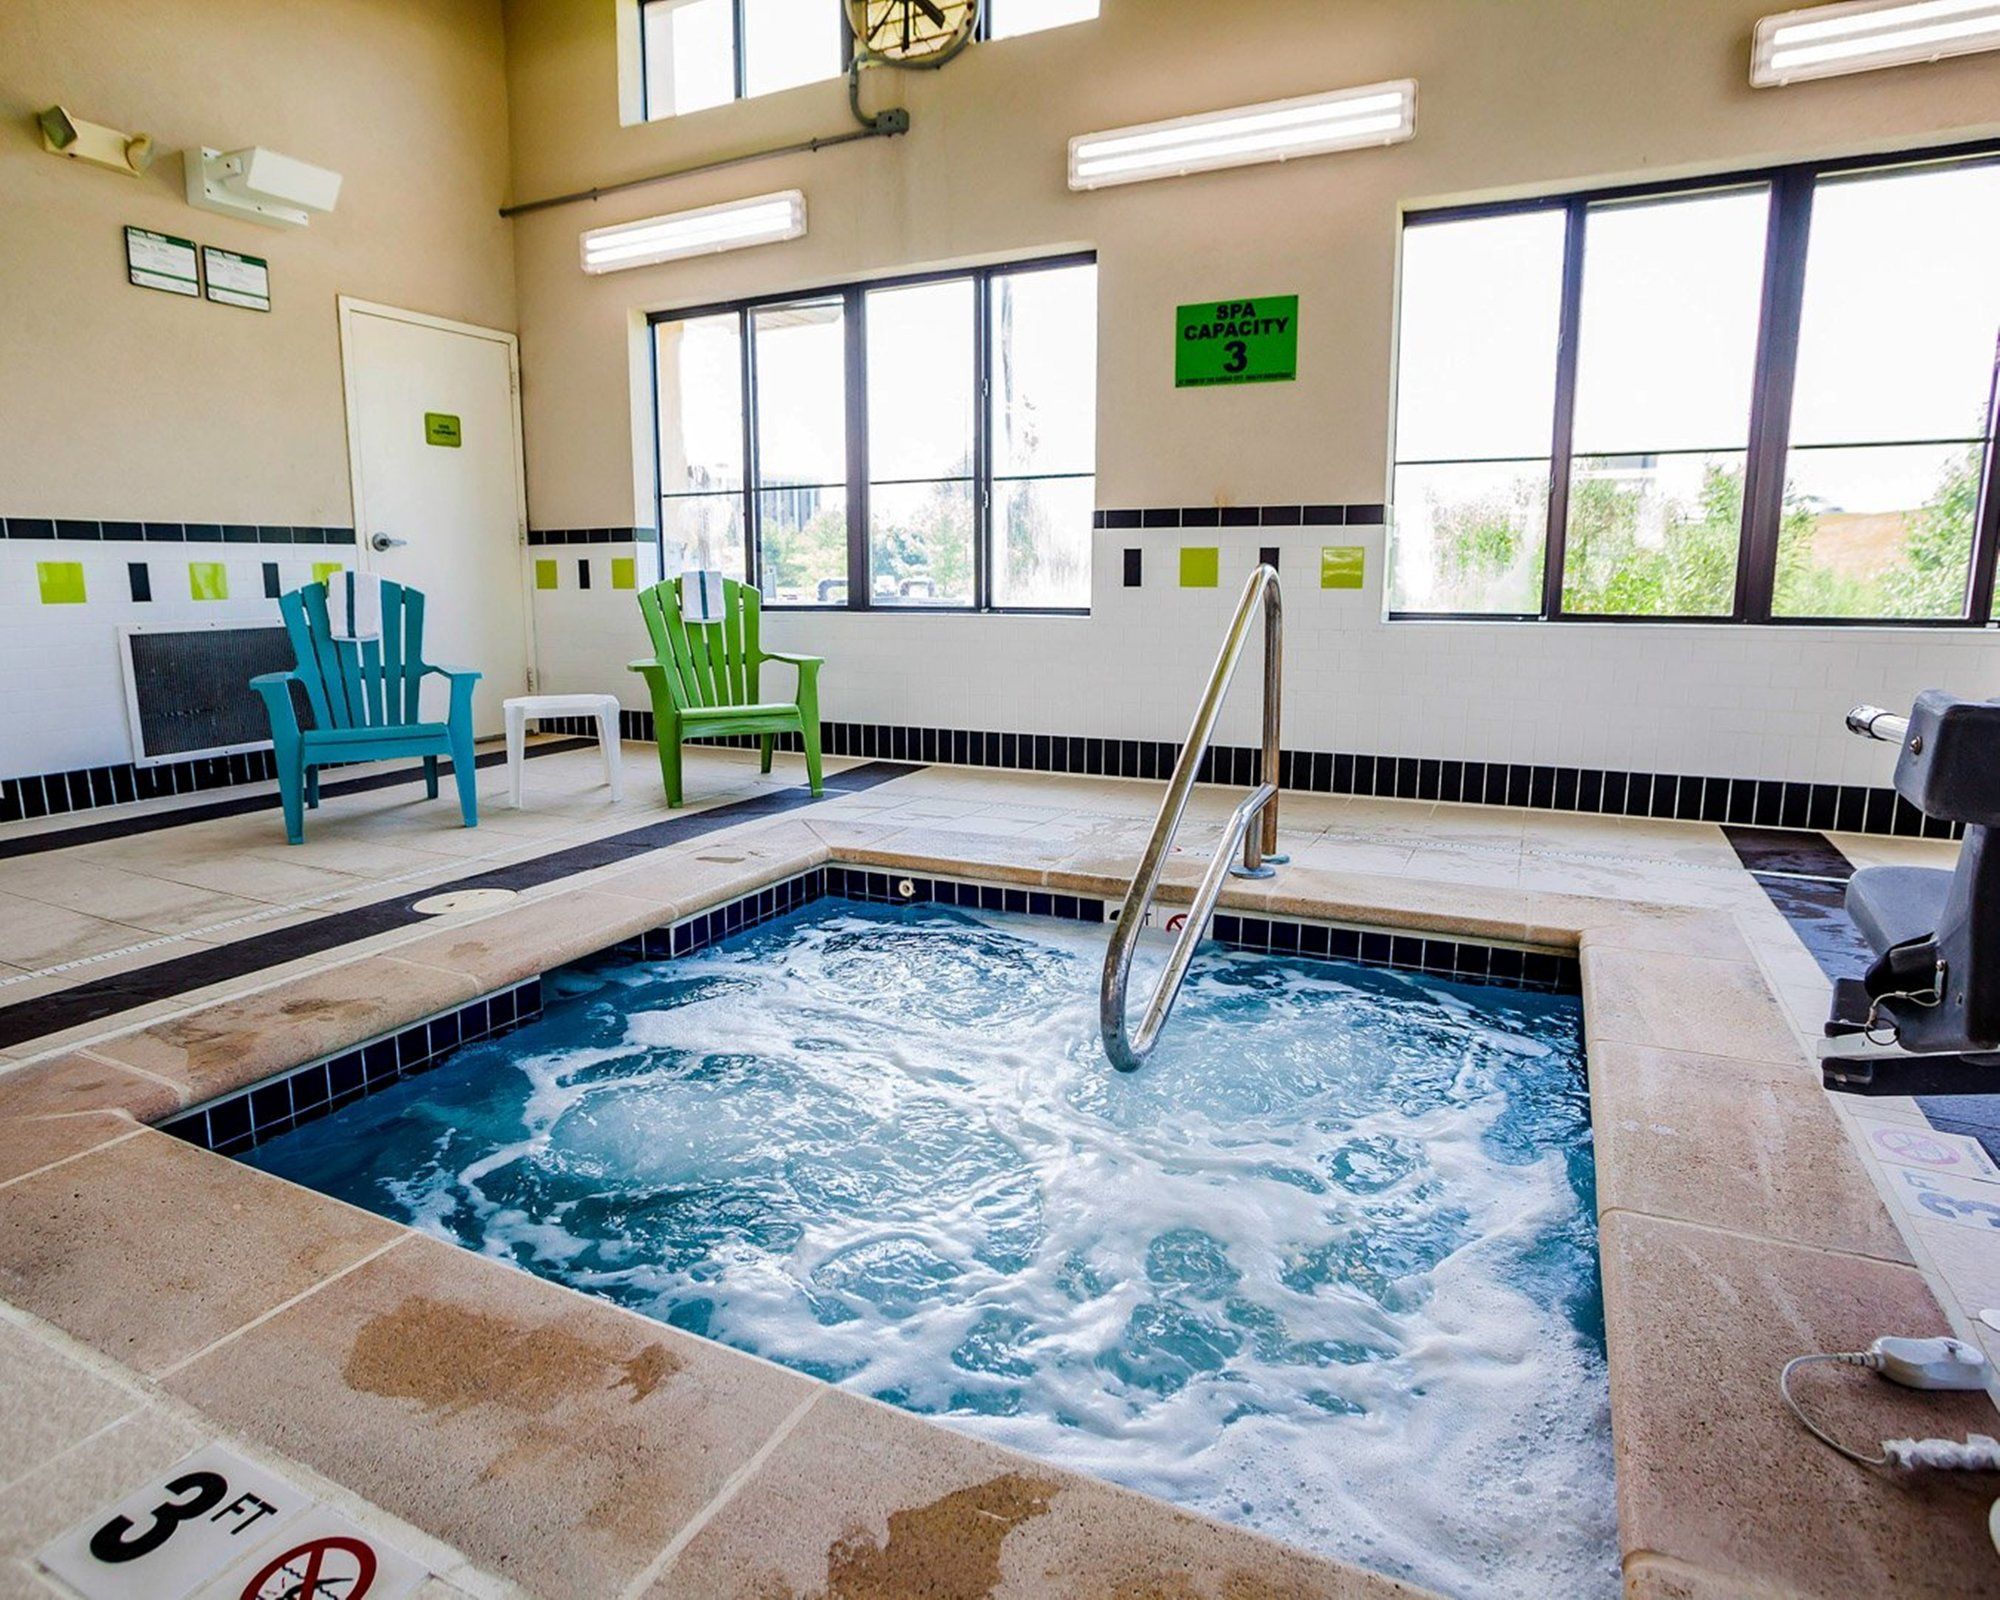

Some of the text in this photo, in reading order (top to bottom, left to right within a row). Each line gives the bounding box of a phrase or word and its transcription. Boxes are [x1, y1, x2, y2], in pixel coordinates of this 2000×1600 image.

[1216, 302, 1256, 321] SPA
[1184, 317, 1289, 341] CAPACITY
[1223, 341, 1248, 373] 3
[89, 1471, 278, 1563] 3 FT
